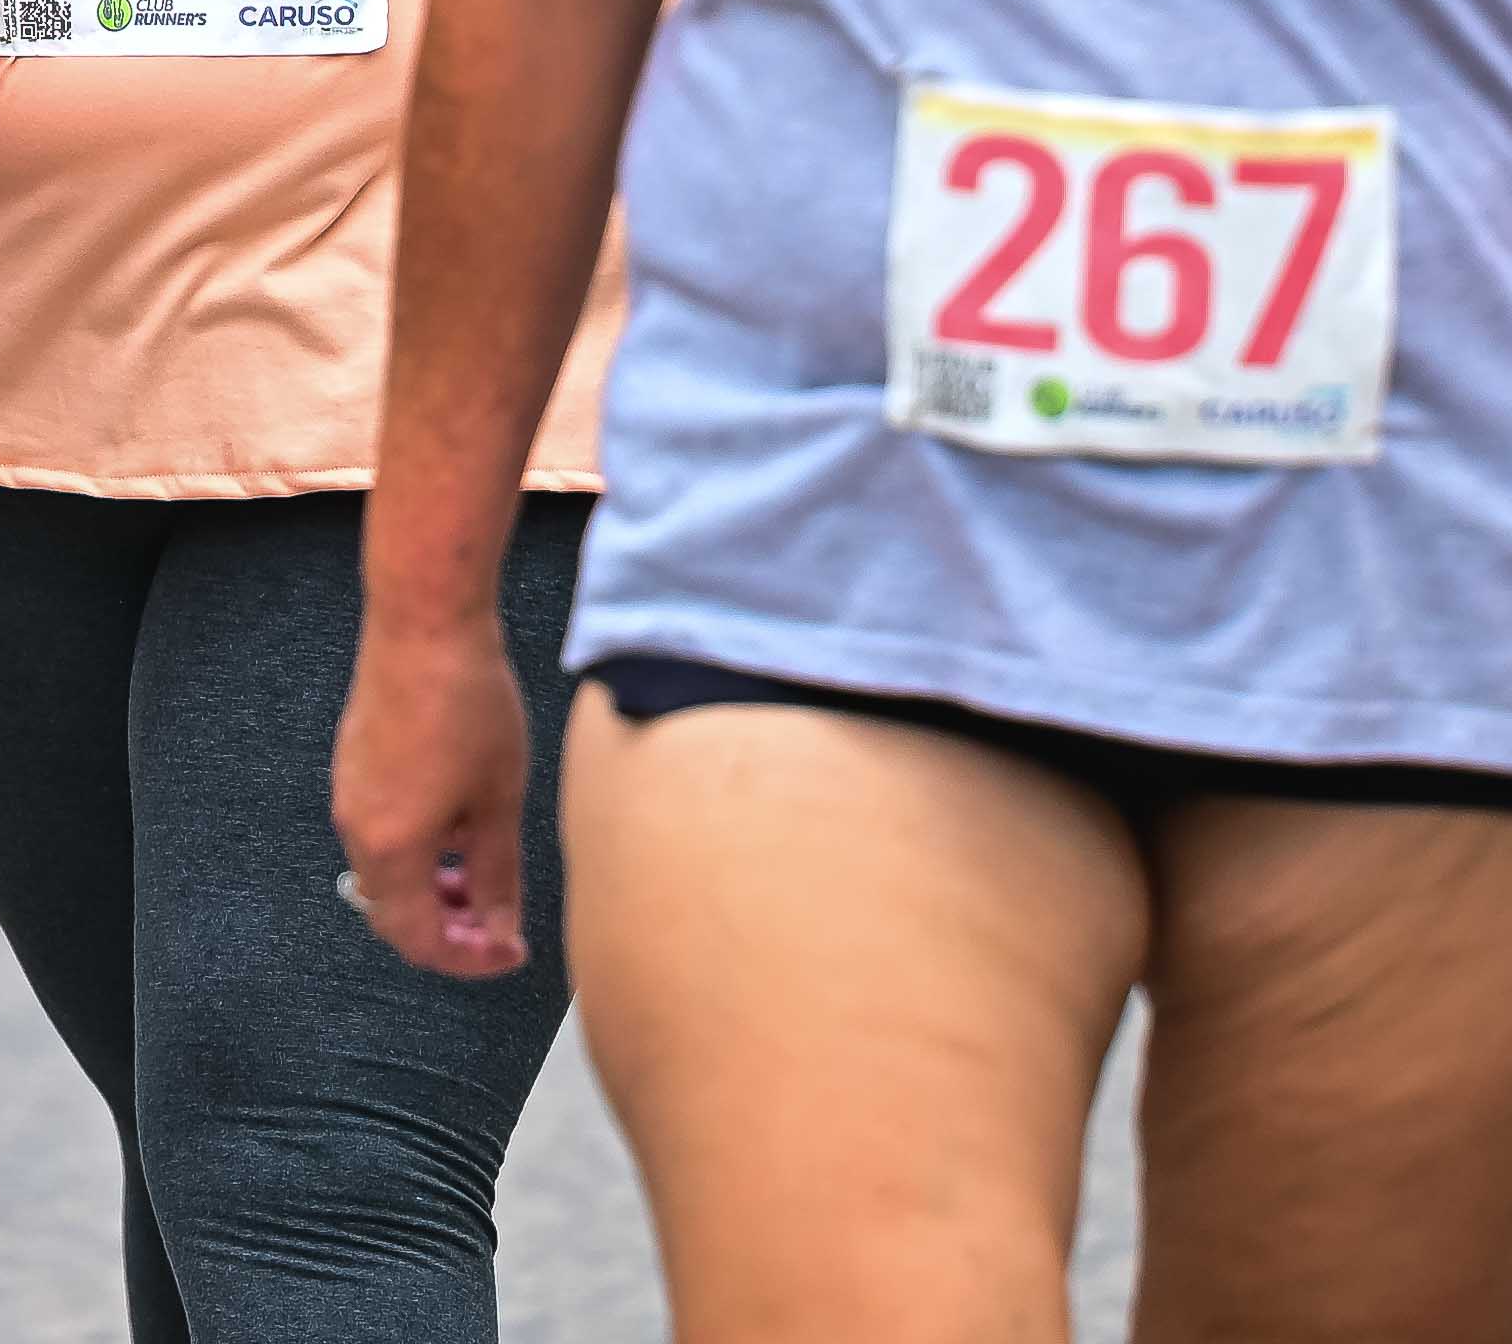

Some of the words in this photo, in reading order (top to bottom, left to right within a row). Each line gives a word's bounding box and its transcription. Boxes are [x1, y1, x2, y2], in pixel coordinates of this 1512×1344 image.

[134, 12, 208, 26] RUNNER'S
[238, 5, 355, 27] CARUSO
[931, 131, 1351, 371] 267
